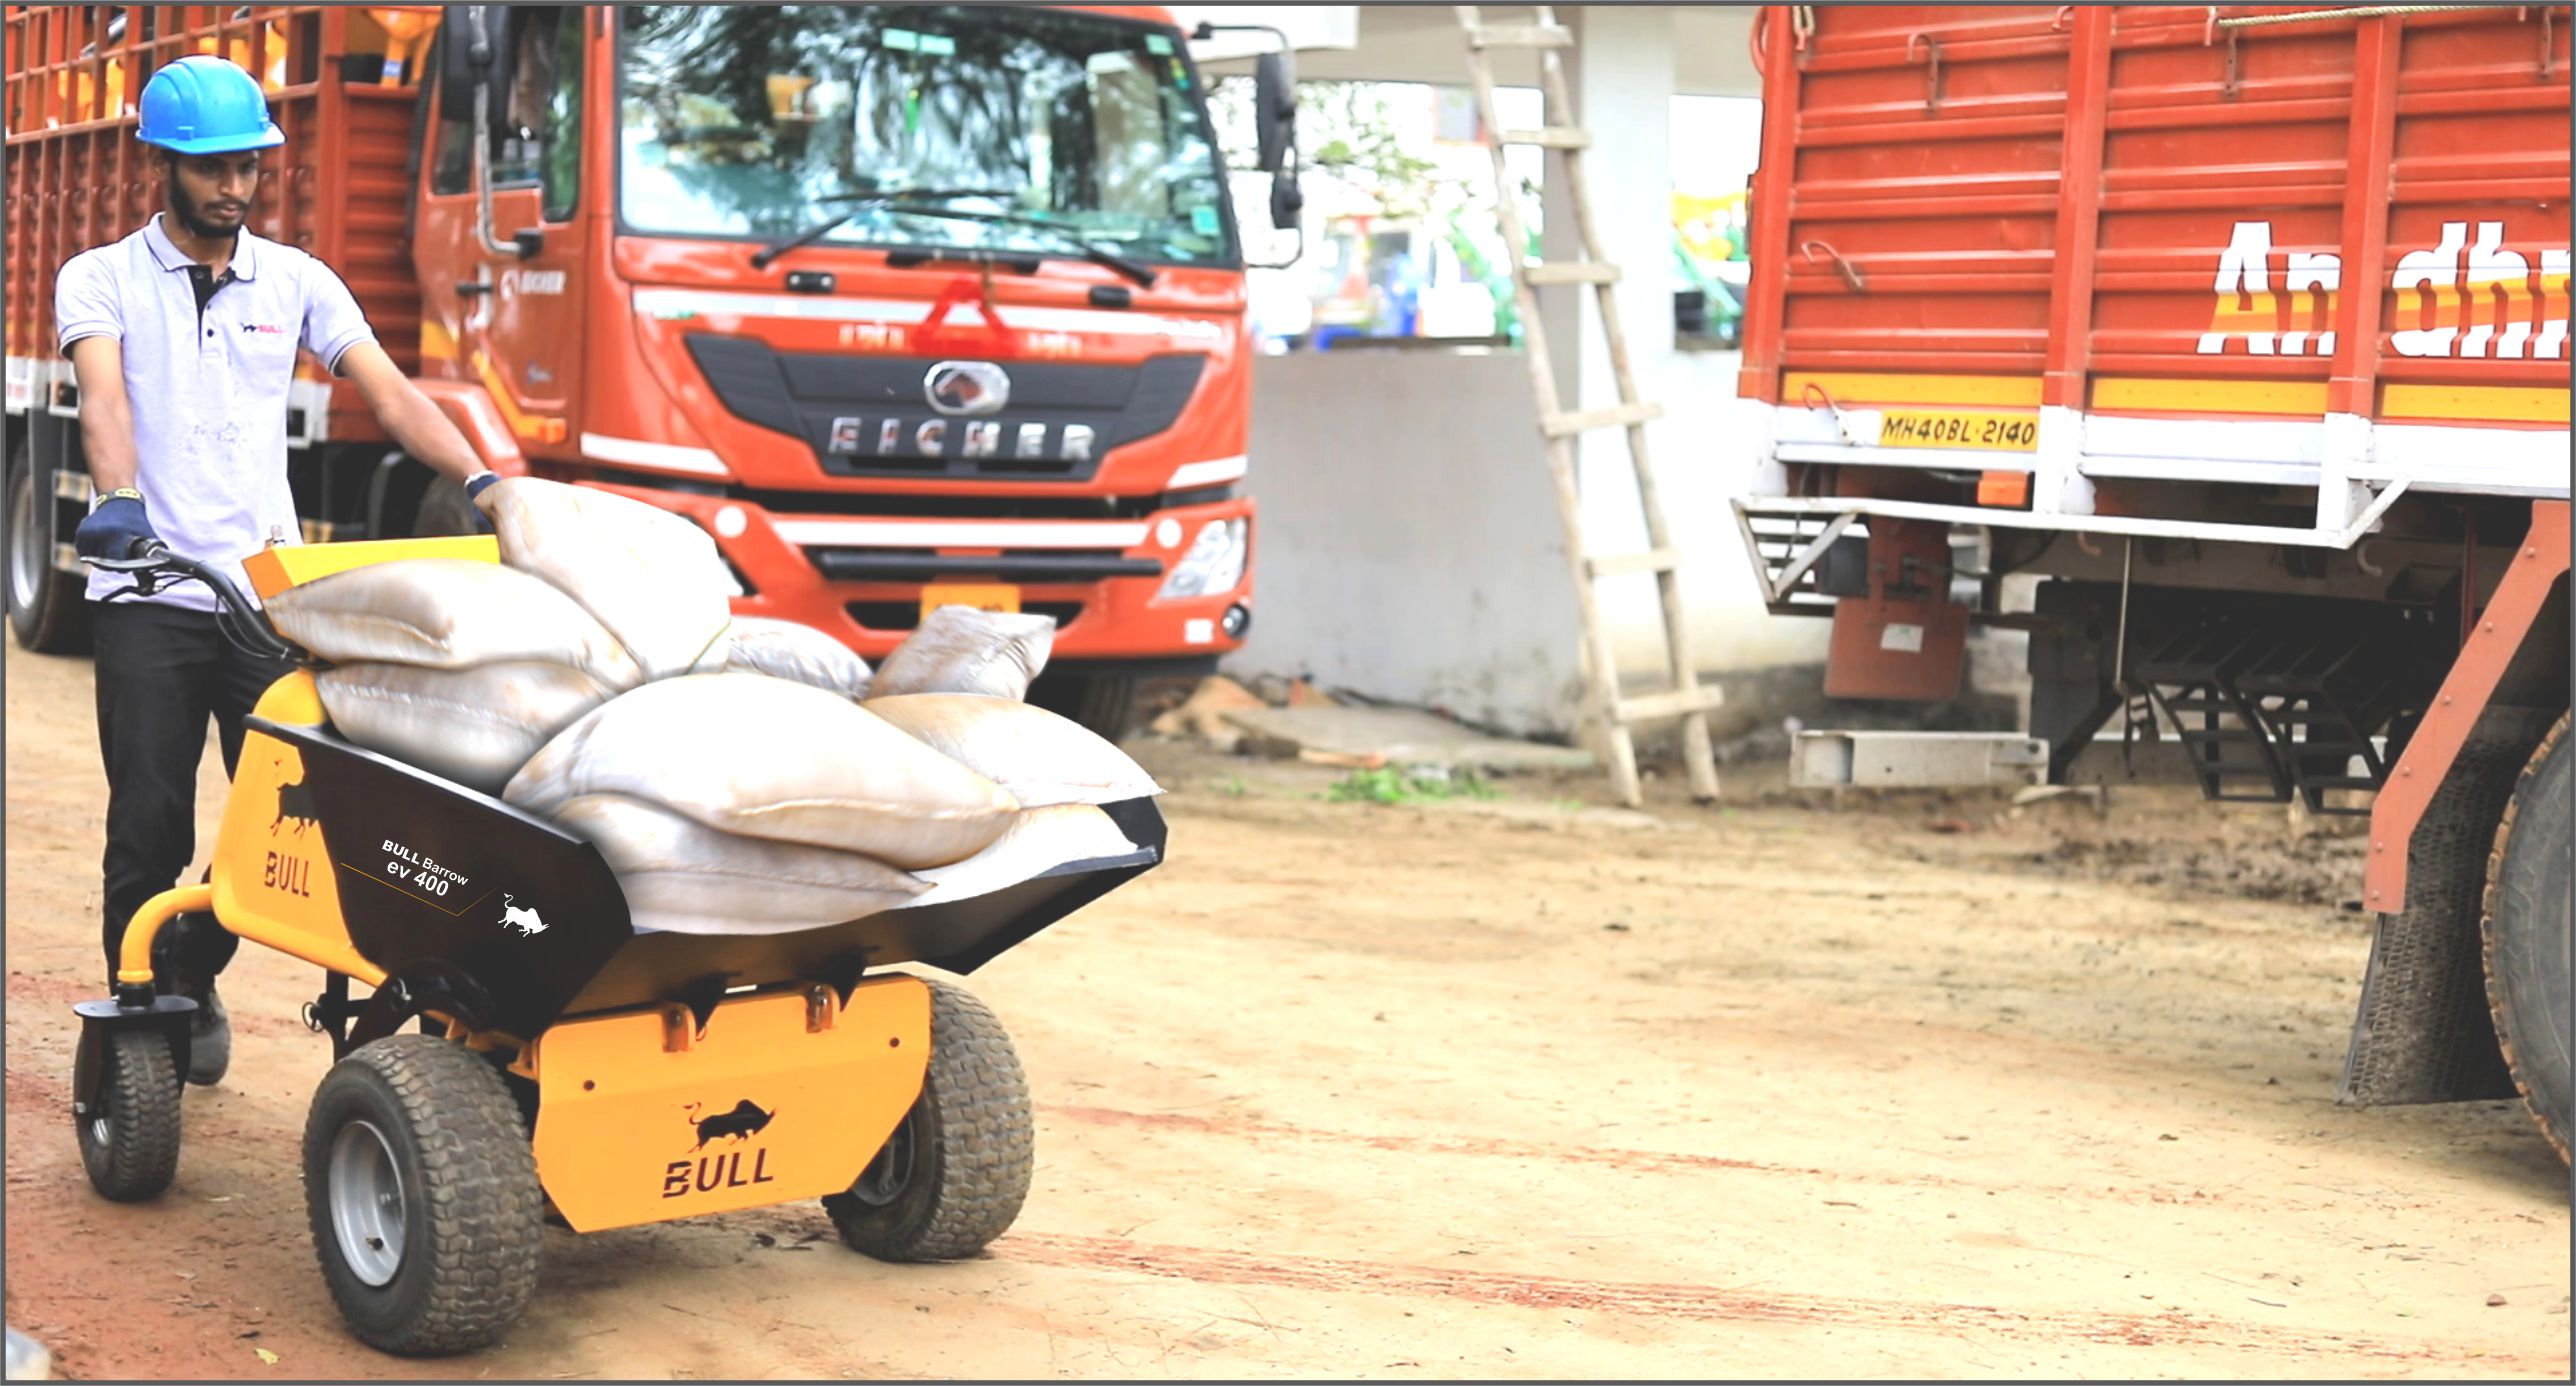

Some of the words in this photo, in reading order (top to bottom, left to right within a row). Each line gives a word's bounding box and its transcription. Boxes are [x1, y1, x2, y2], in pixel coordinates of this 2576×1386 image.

[828, 416, 1095, 460] EICHER
[264, 850, 310, 898] BULL
[382, 839, 420, 865] BULL
[422, 857, 469, 886] Barrow
[387, 861, 412, 879] ev
[413, 871, 449, 896] 400
[662, 1147, 774, 1199] BULL
